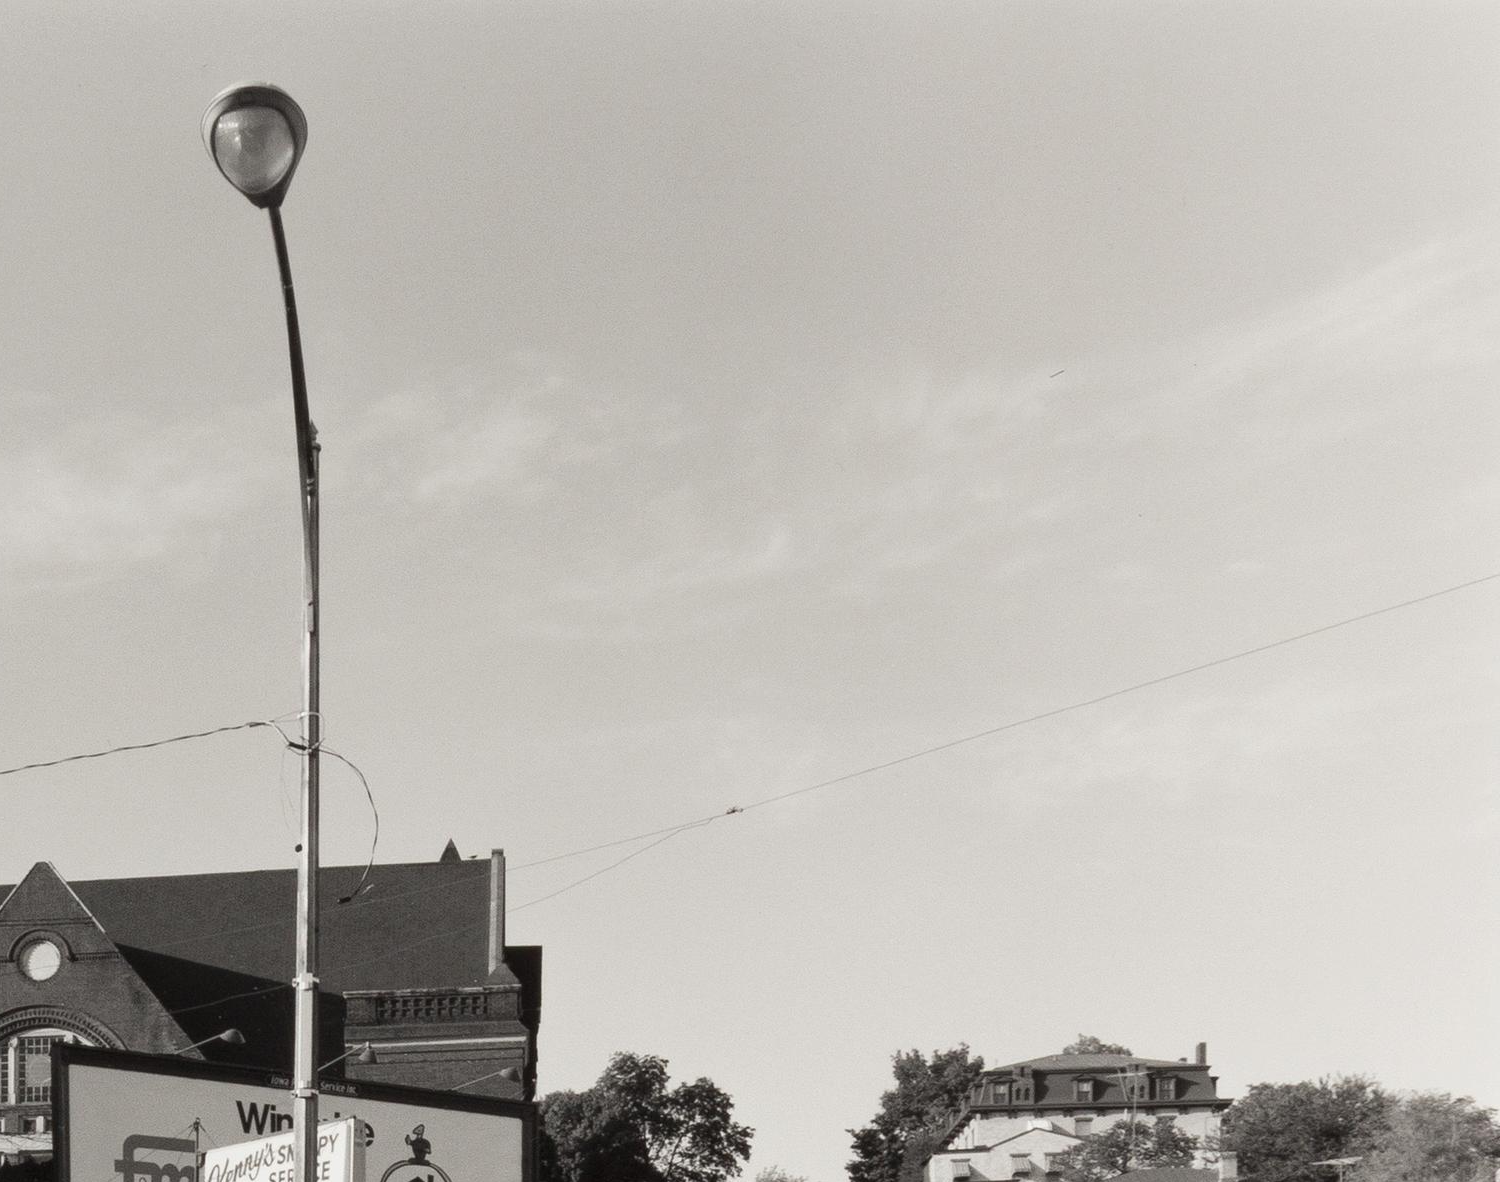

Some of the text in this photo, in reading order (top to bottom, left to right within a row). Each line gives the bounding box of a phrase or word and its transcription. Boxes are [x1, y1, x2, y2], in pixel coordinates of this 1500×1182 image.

[271, 1075, 289, 1087] Iowa
[320, 1082, 345, 1093] Service
[277, 1132, 339, 1165] SNPY
